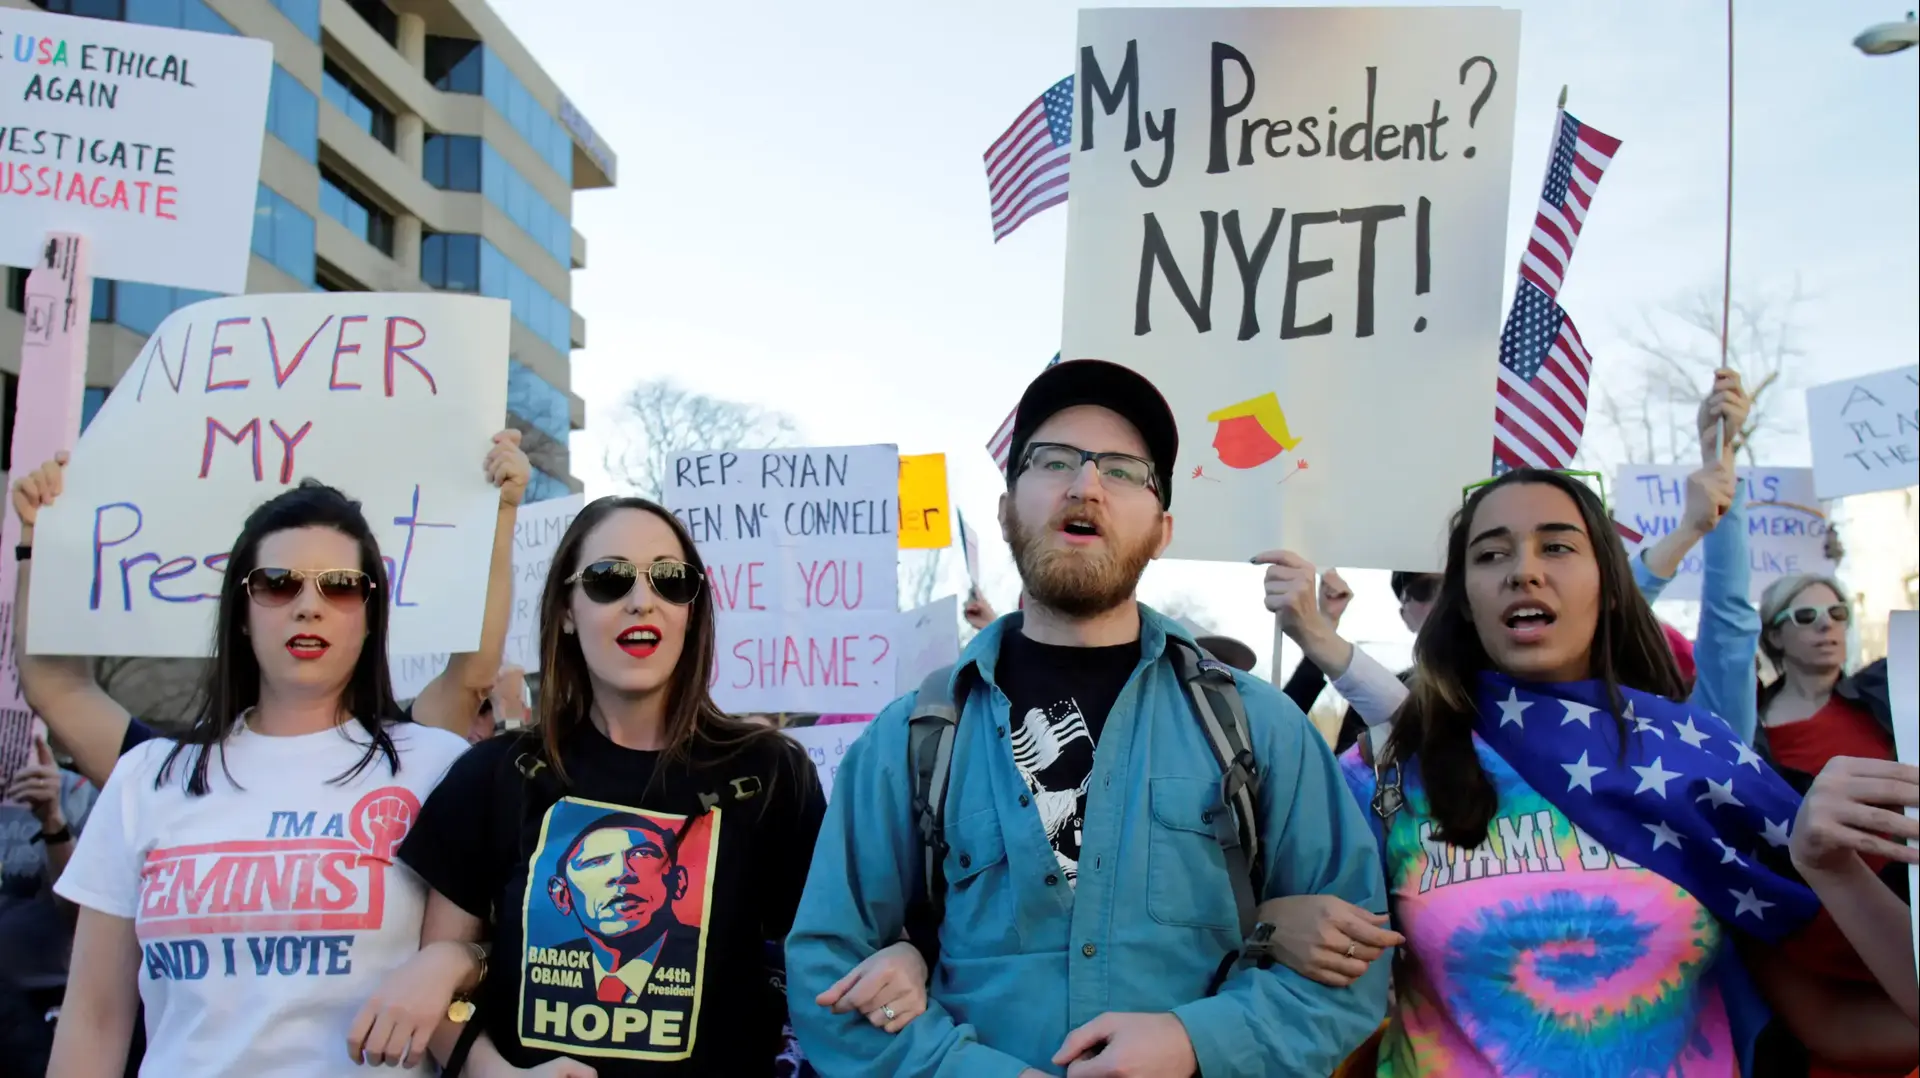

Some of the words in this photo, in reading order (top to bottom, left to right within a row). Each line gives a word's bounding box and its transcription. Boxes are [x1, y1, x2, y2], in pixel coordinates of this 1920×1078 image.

[14, 33, 69, 67] USA
[80, 44, 197, 88] ETHICAL
[24, 74, 118, 109] AGAIN
[1080, 39, 1176, 188] My
[1205, 41, 1498, 174] President?
[1134, 196, 1431, 341] NYET!
[138, 314, 437, 402] NEVER
[1840, 384, 1886, 417] A
[198, 416, 313, 484] MY
[676, 452, 742, 488] REP.
[762, 453, 848, 488] RYAN
[784, 499, 893, 536] CONNELL
[1748, 515, 1827, 538] MERICA
[1749, 548, 1803, 575] LIKE
[705, 562, 766, 611] AVE
[797, 560, 862, 611] YOU
[732, 634, 890, 690] SHAME?
[266, 811, 317, 837] I'M
[321, 813, 344, 837] A
[139, 852, 393, 919] EMINIST
[145, 938, 210, 981] AND
[221, 937, 238, 977] I
[247, 935, 355, 976] VOTE
[528, 946, 591, 969] BARACK
[655, 966, 691, 984] 44th
[531, 966, 584, 988] OBAMA
[647, 982, 695, 998] President
[533, 998, 684, 1047] HOPE
